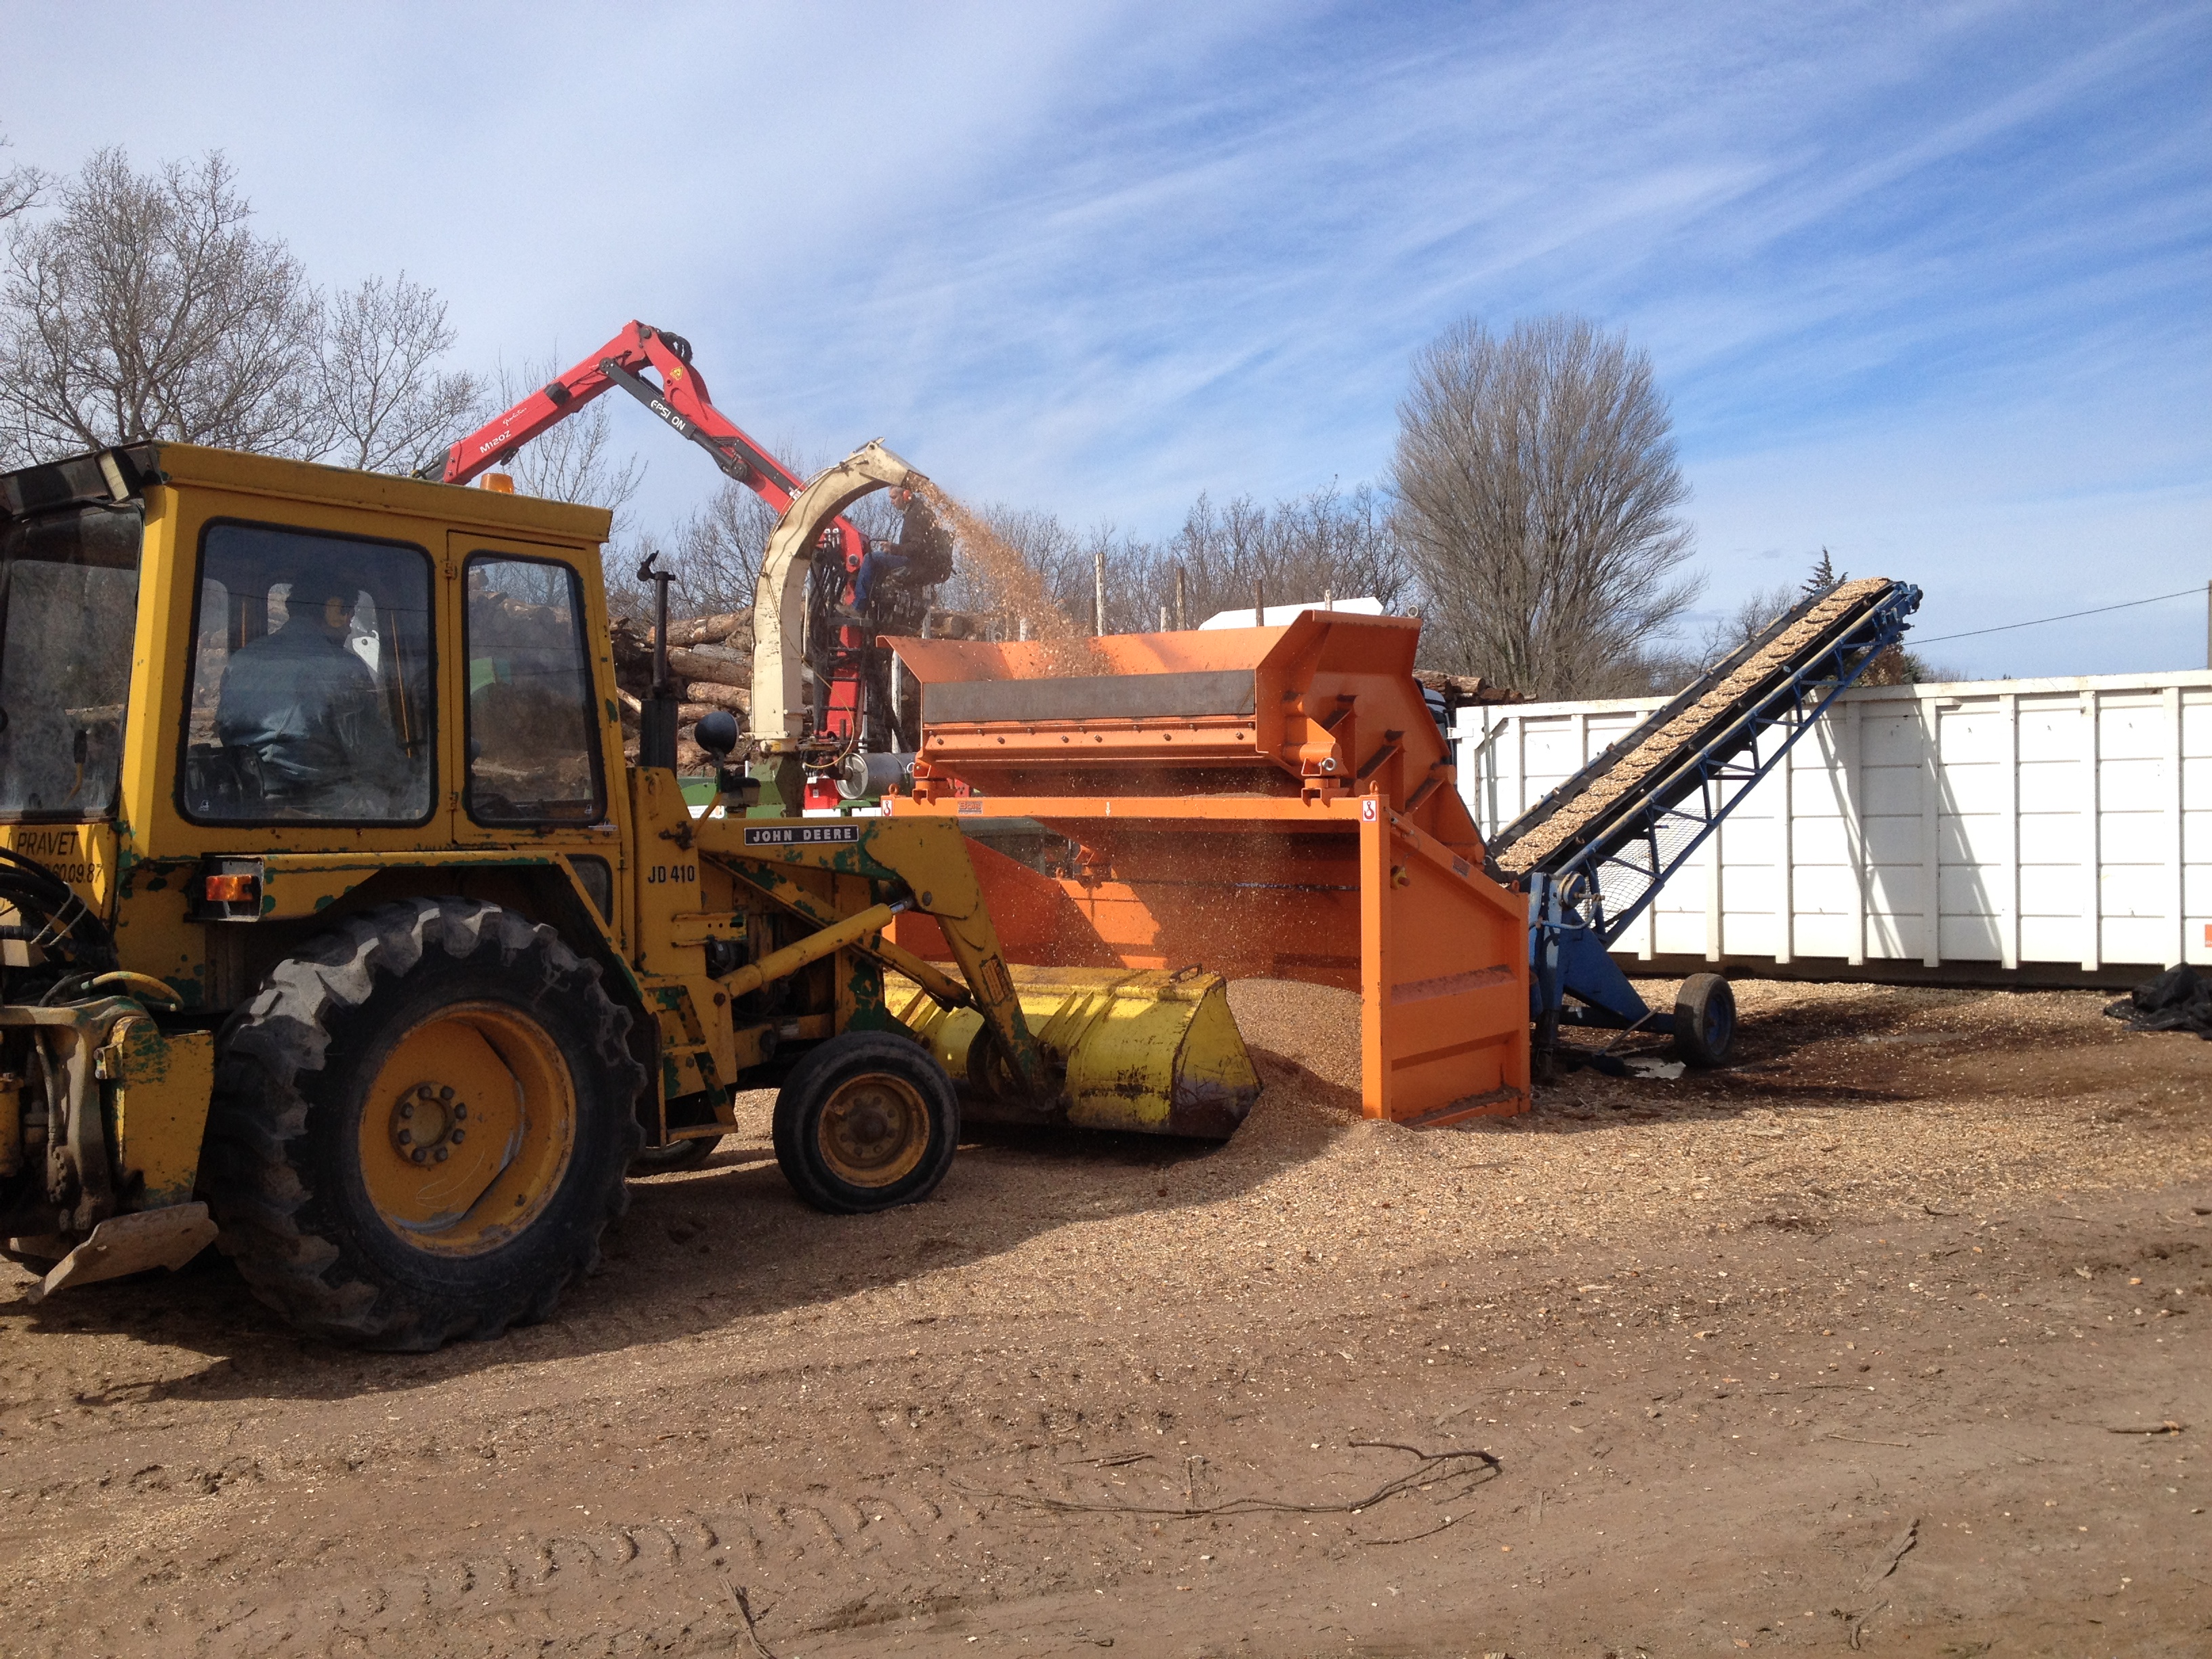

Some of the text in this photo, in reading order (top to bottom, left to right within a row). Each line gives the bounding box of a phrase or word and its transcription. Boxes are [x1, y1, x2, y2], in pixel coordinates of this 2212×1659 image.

[651, 399, 686, 431] EPSION
[17, 830, 79, 856] PRAVET
[753, 827, 851, 843] JOHN DEERE
[648, 864, 695, 883] JD 410
